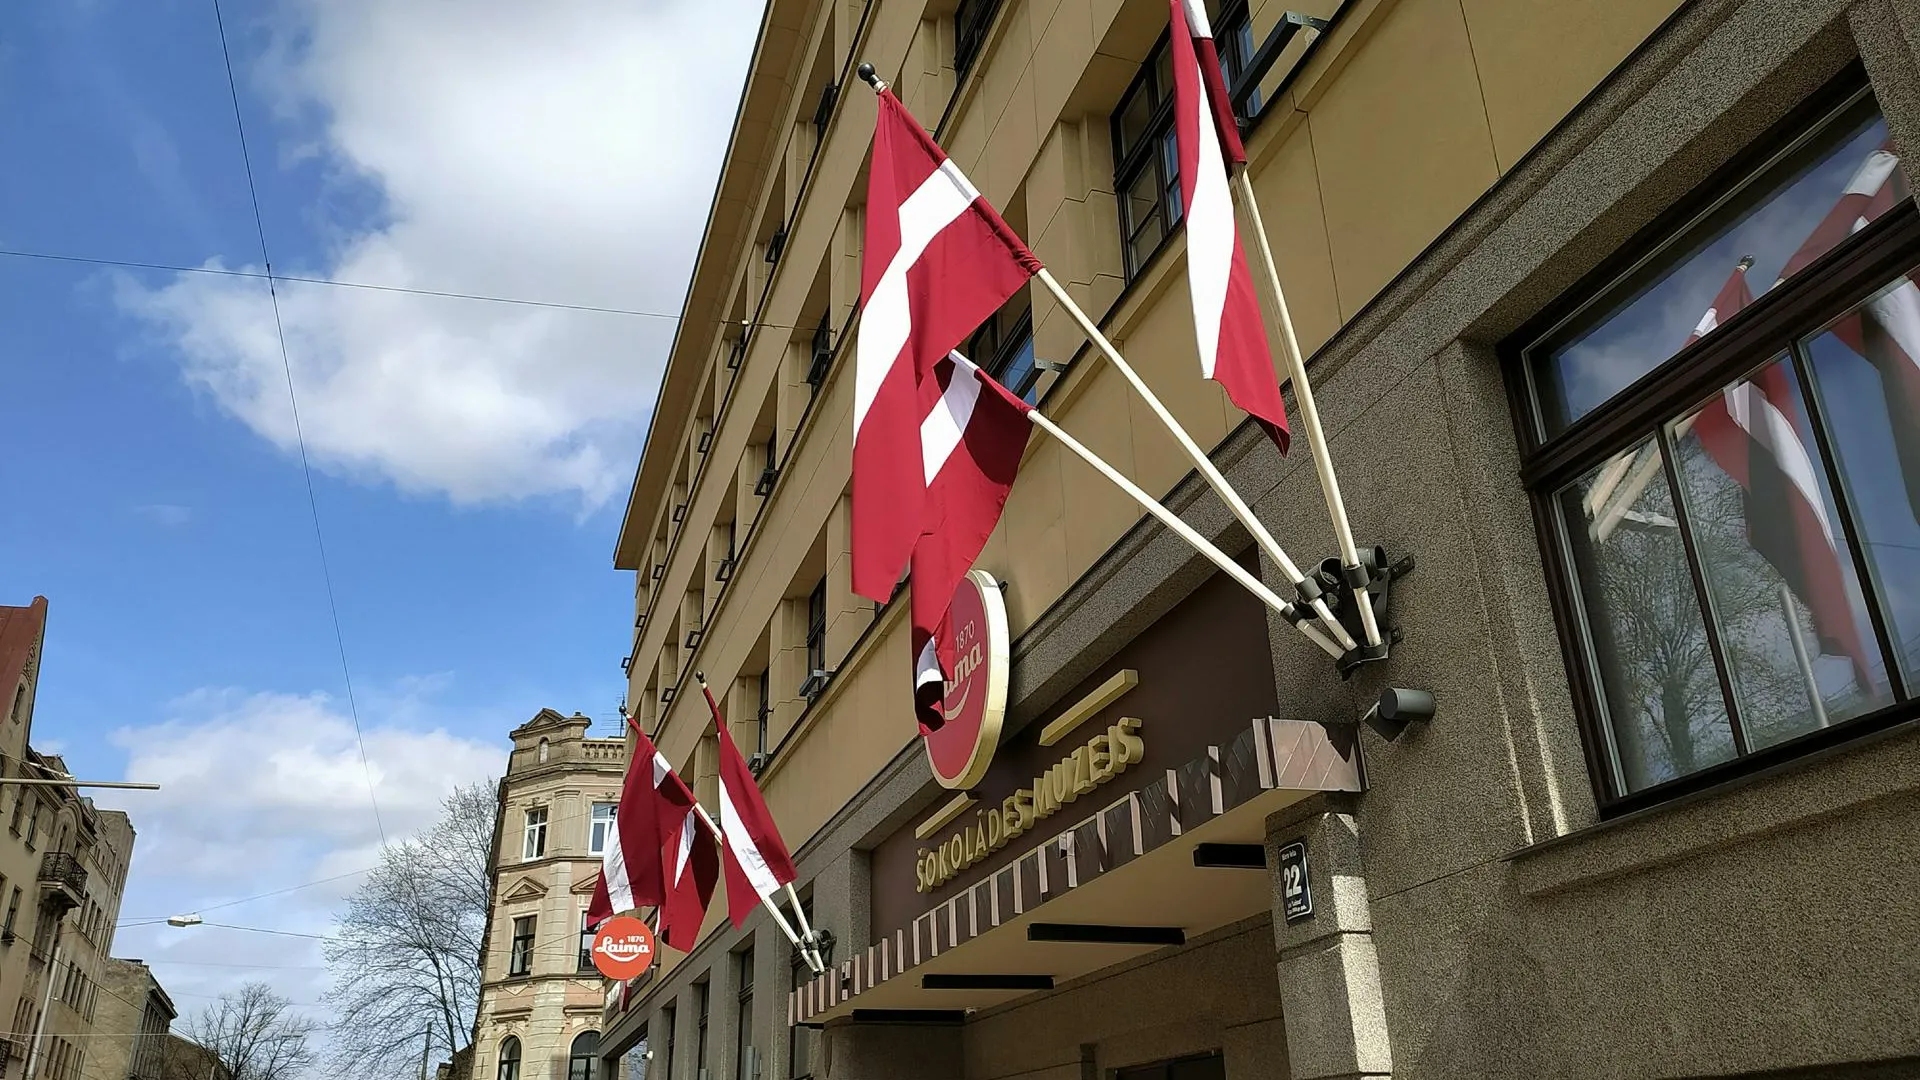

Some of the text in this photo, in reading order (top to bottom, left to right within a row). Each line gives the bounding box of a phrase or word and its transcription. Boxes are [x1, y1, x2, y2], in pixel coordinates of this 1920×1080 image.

[955, 620, 975, 653] 1870
[916, 717, 1144, 892] ŠOKOLĀDES MUZEJS
[1284, 864, 1302, 898] 22
[595, 936, 650, 961] Laima
[627, 935, 644, 943] 1870
